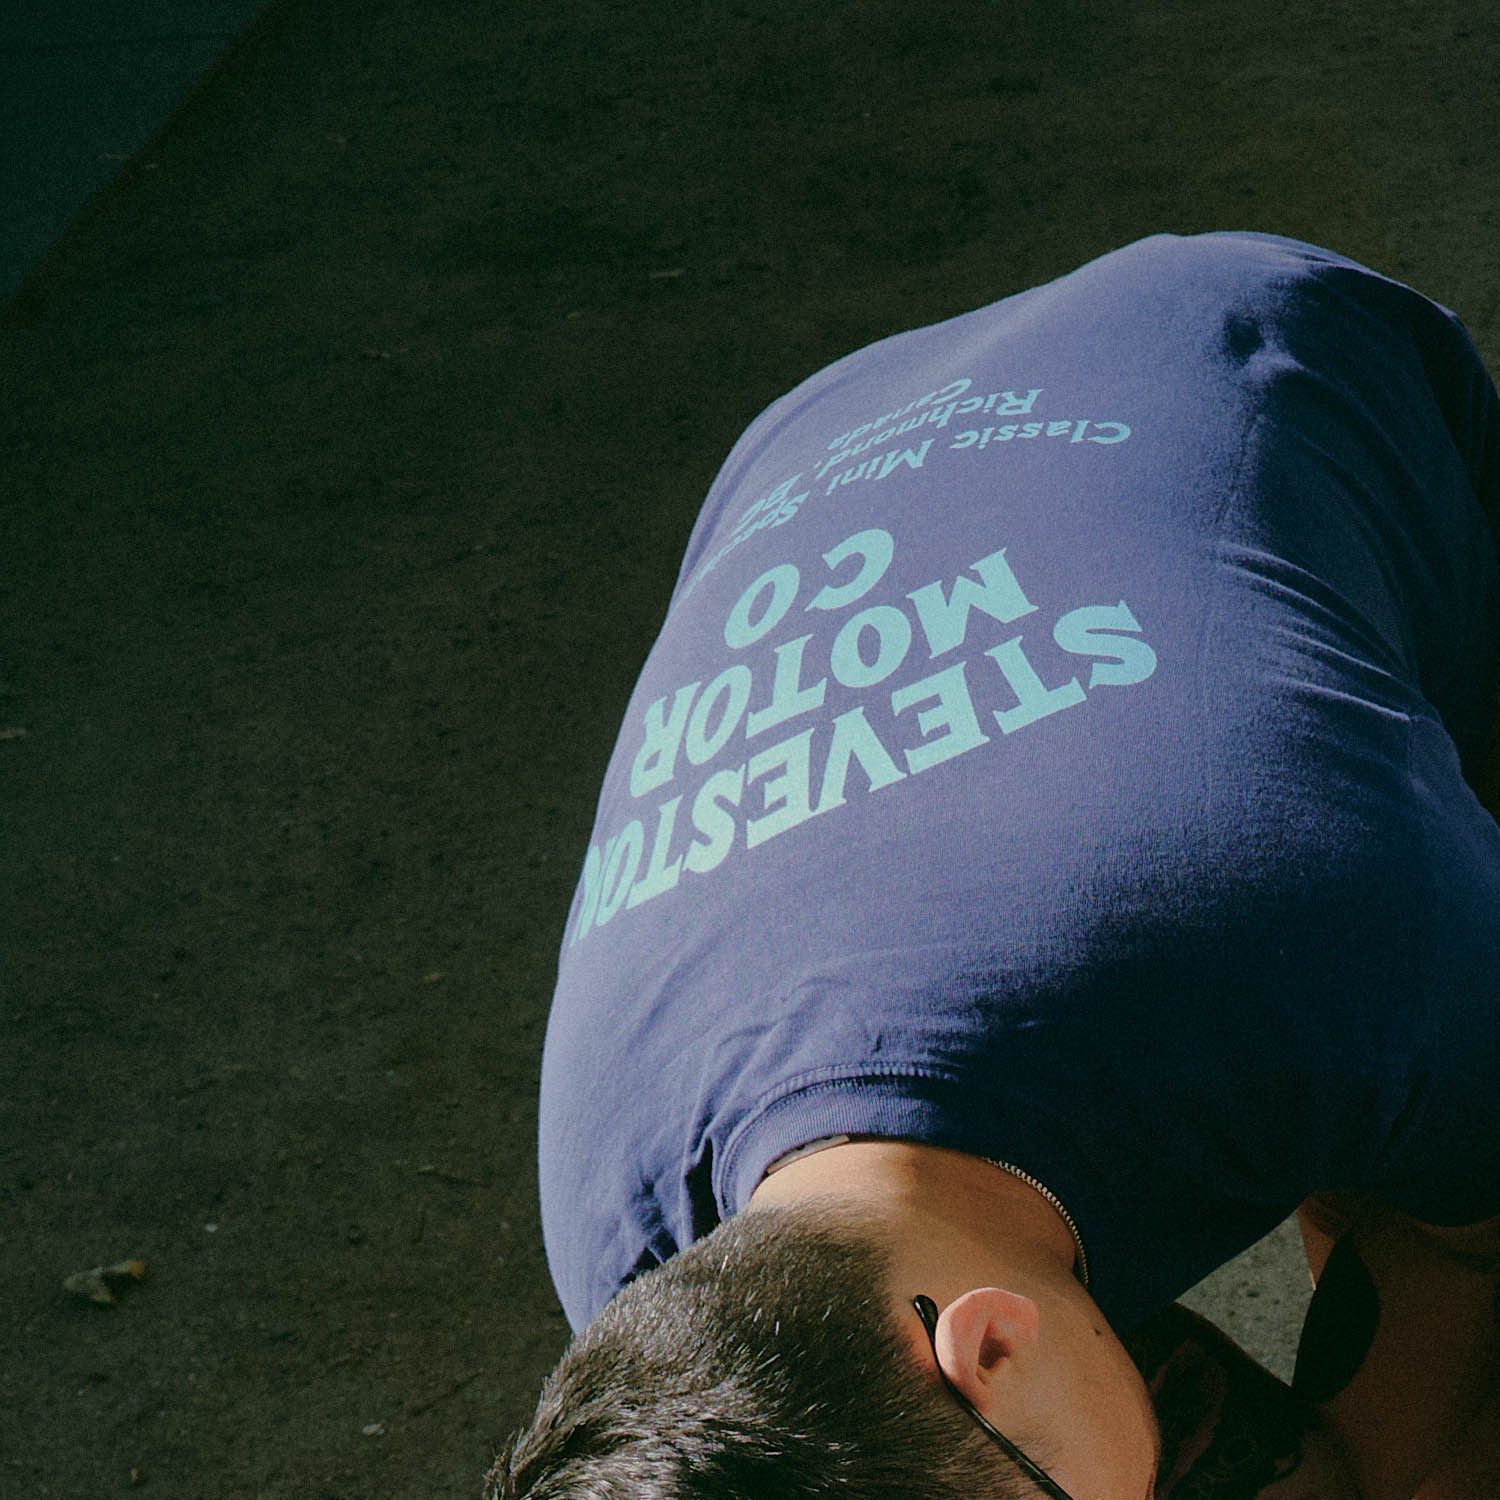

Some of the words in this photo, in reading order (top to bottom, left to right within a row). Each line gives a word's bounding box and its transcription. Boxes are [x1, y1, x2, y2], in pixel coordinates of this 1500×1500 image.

[826, 378, 972, 451] Canada
[949, 419, 1131, 449] Classic
[825, 438, 935, 496] Mini
[724, 528, 893, 649] CO
[630, 547, 1039, 798] MOTOR
[570, 600, 1158, 945] STEVESTON
